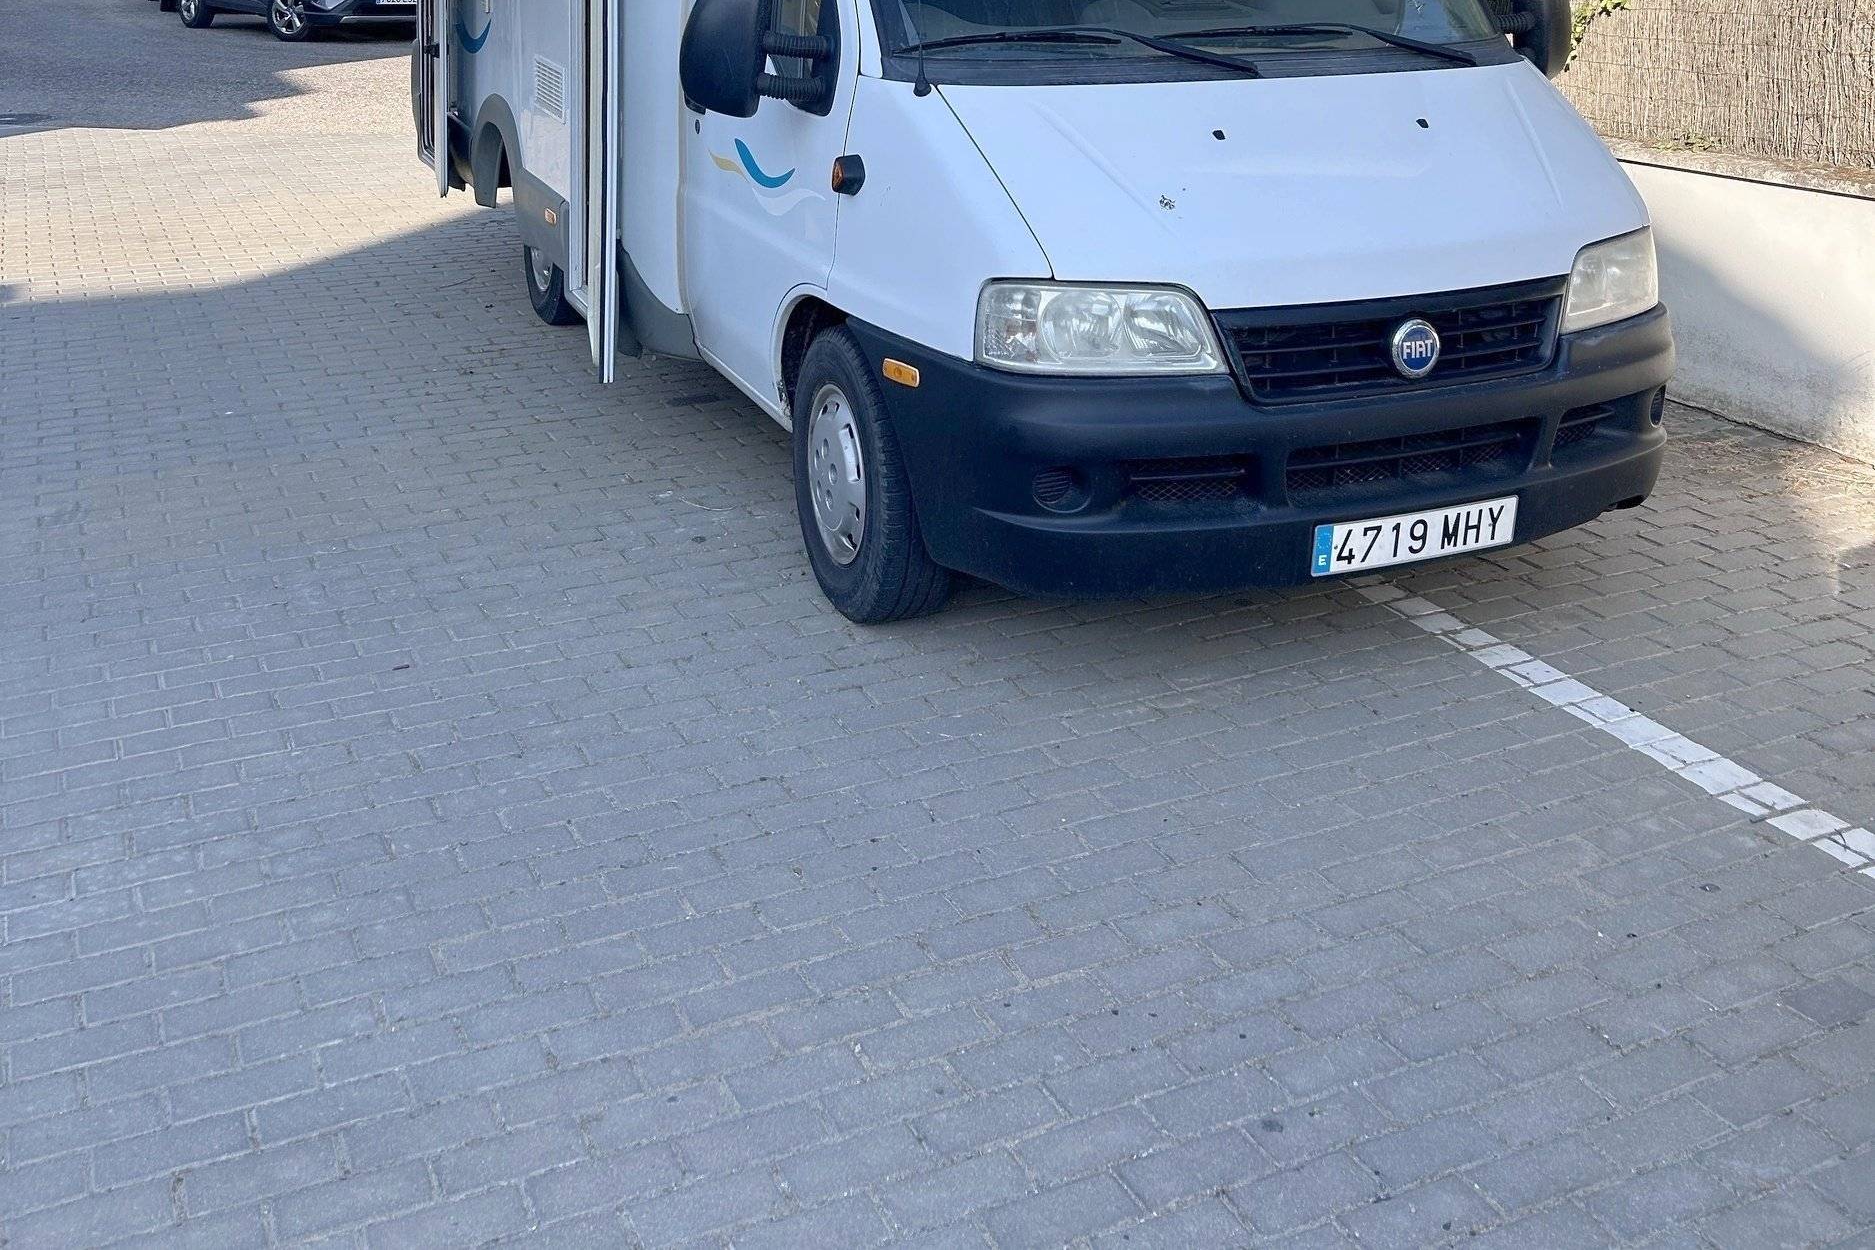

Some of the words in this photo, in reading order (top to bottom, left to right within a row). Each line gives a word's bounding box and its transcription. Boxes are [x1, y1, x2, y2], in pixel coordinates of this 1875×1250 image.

[1402, 339, 1433, 360] FIAT
[1318, 554, 1328, 566] E
[1335, 518, 1429, 565] 4719
[1440, 505, 1505, 550] MHY
